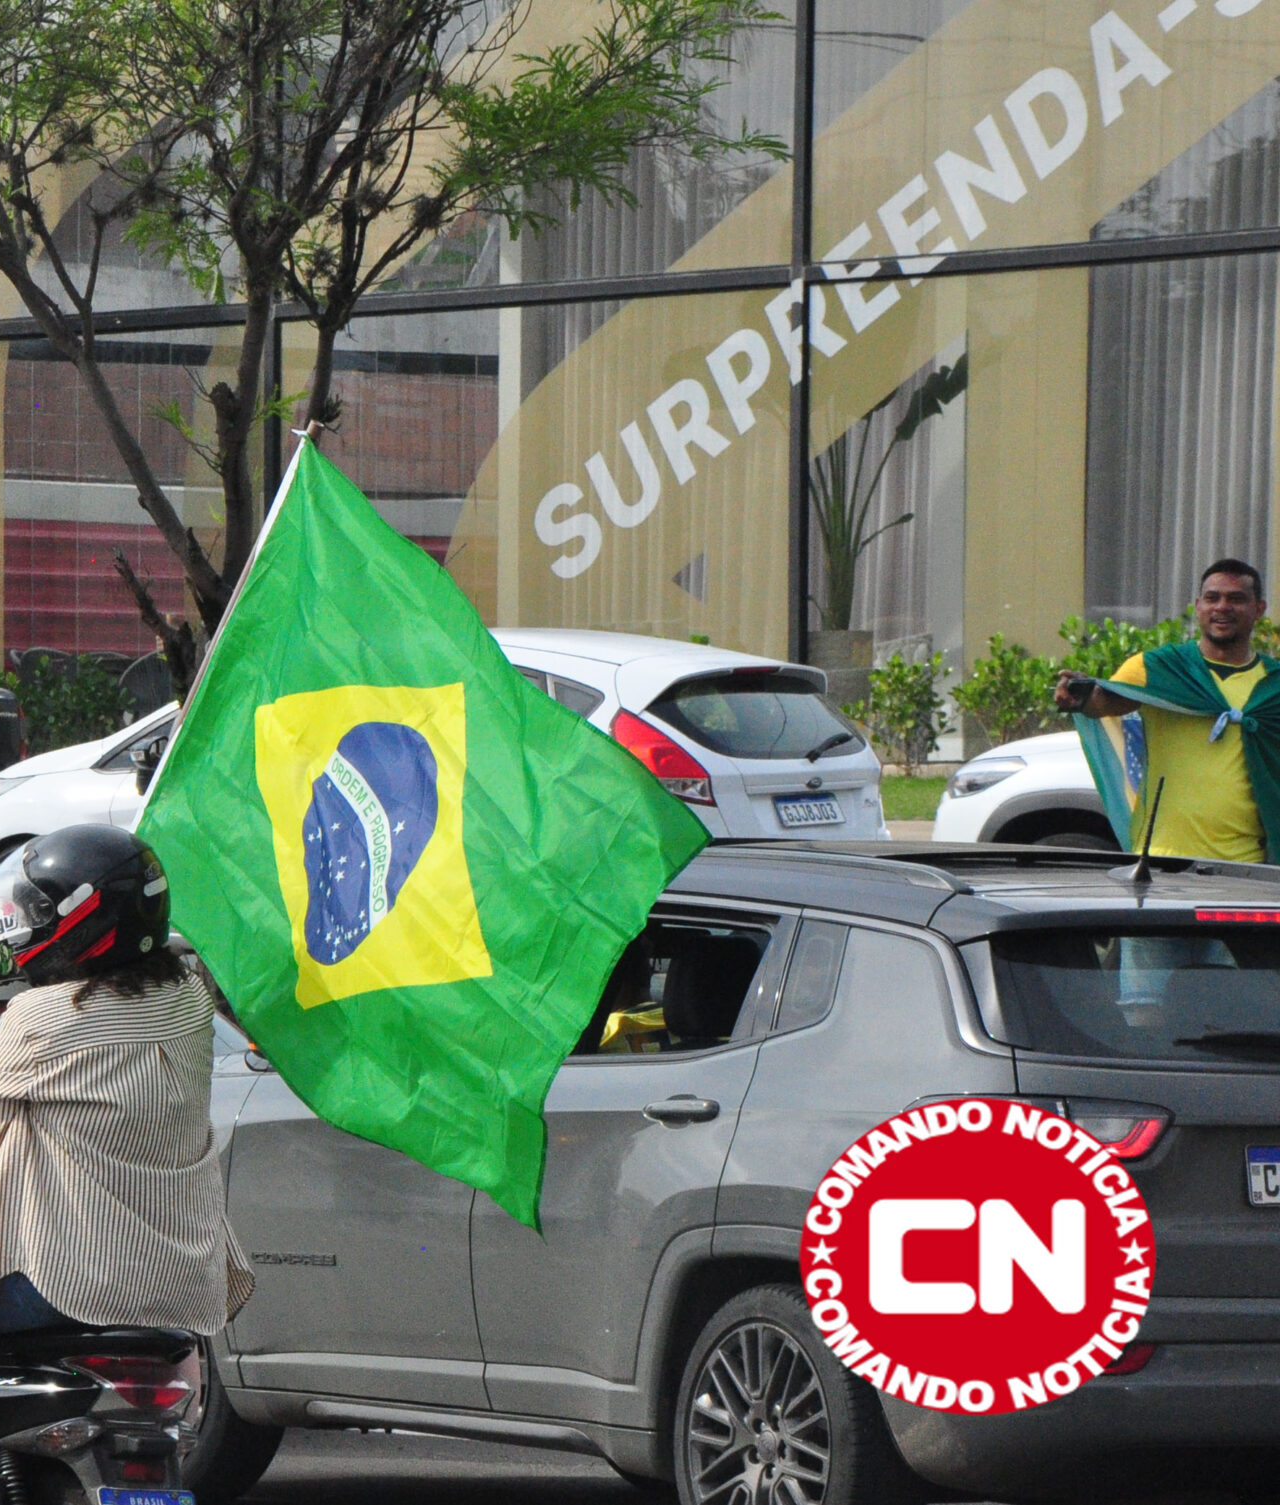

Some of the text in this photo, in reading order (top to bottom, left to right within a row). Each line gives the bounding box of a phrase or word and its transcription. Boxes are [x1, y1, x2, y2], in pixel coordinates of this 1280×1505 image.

[534, 0, 1261, 580] SURPREENDA-
[331, 757, 386, 912] ORDEM E PROGRESSO
